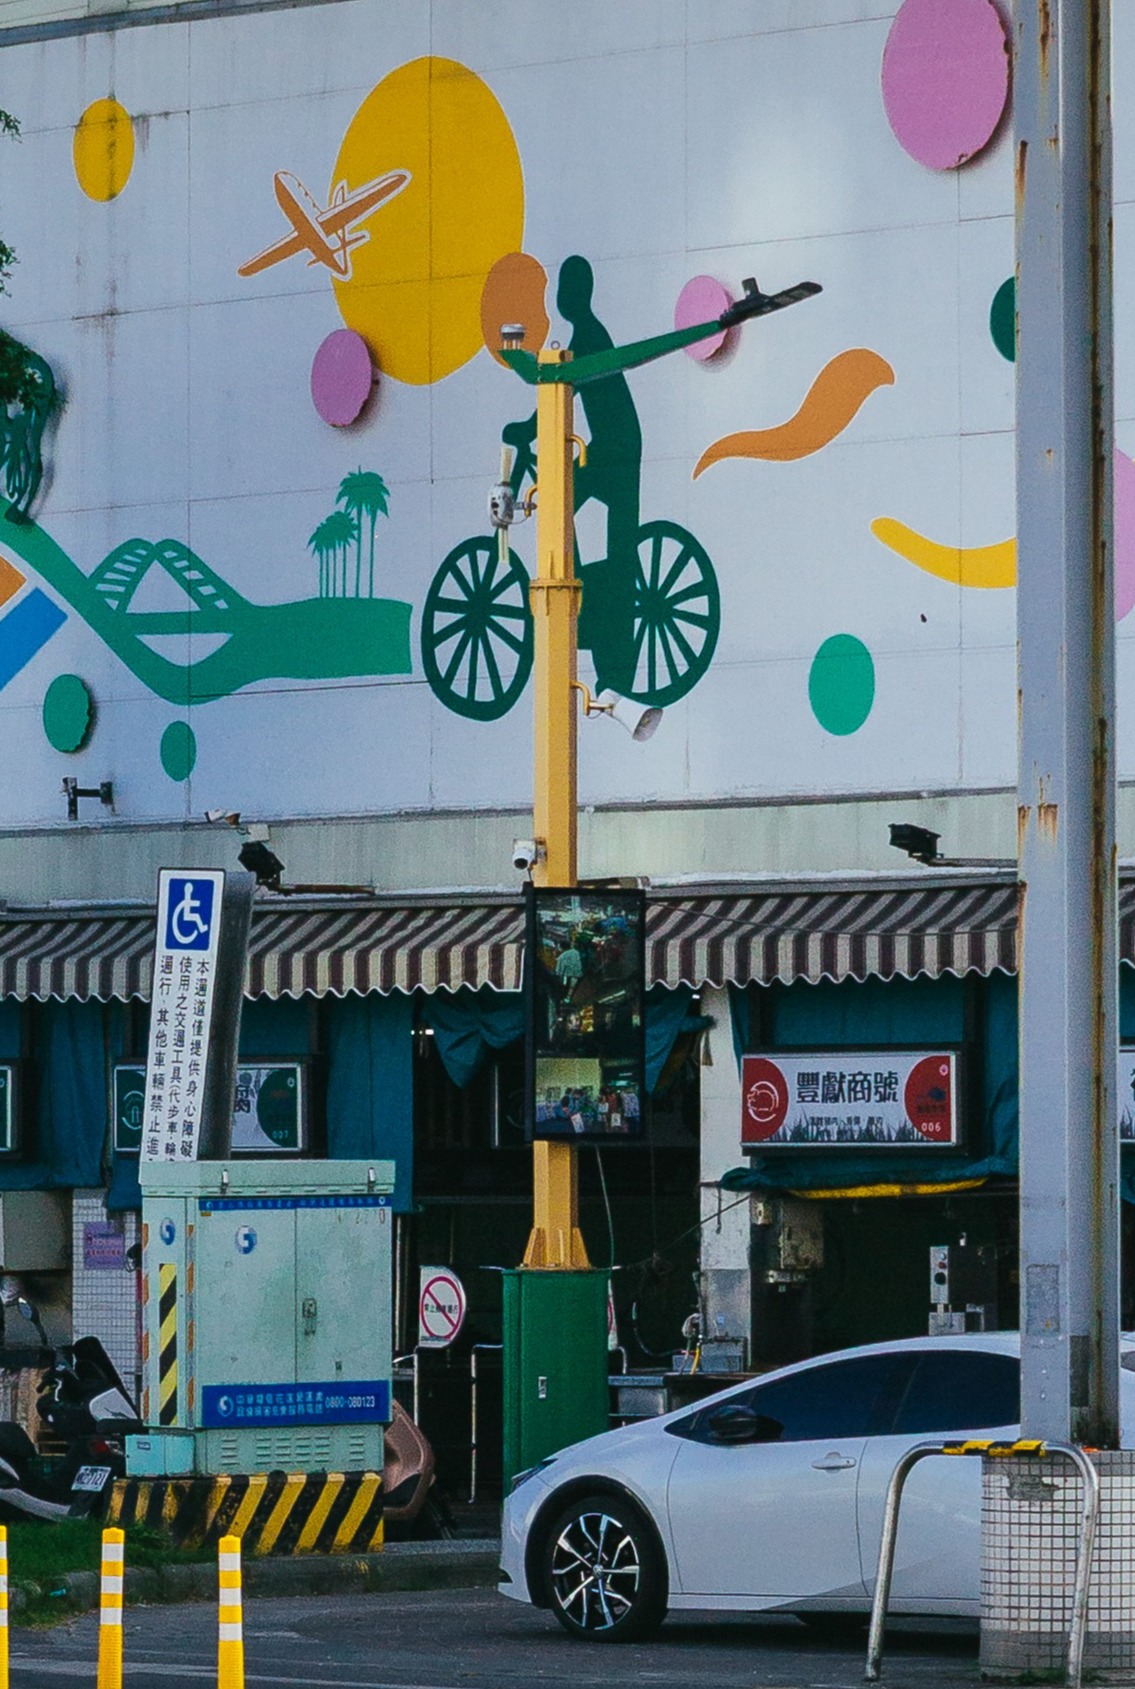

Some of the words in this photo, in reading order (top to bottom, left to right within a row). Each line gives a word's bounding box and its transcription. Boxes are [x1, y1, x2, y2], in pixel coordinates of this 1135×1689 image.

[796, 1071, 899, 1104] 豐獻商號
[921, 1122, 942, 1133] 006
[272, 1130, 289, 1139] 007
[325, 1395, 376, 1408] 0800-080123
